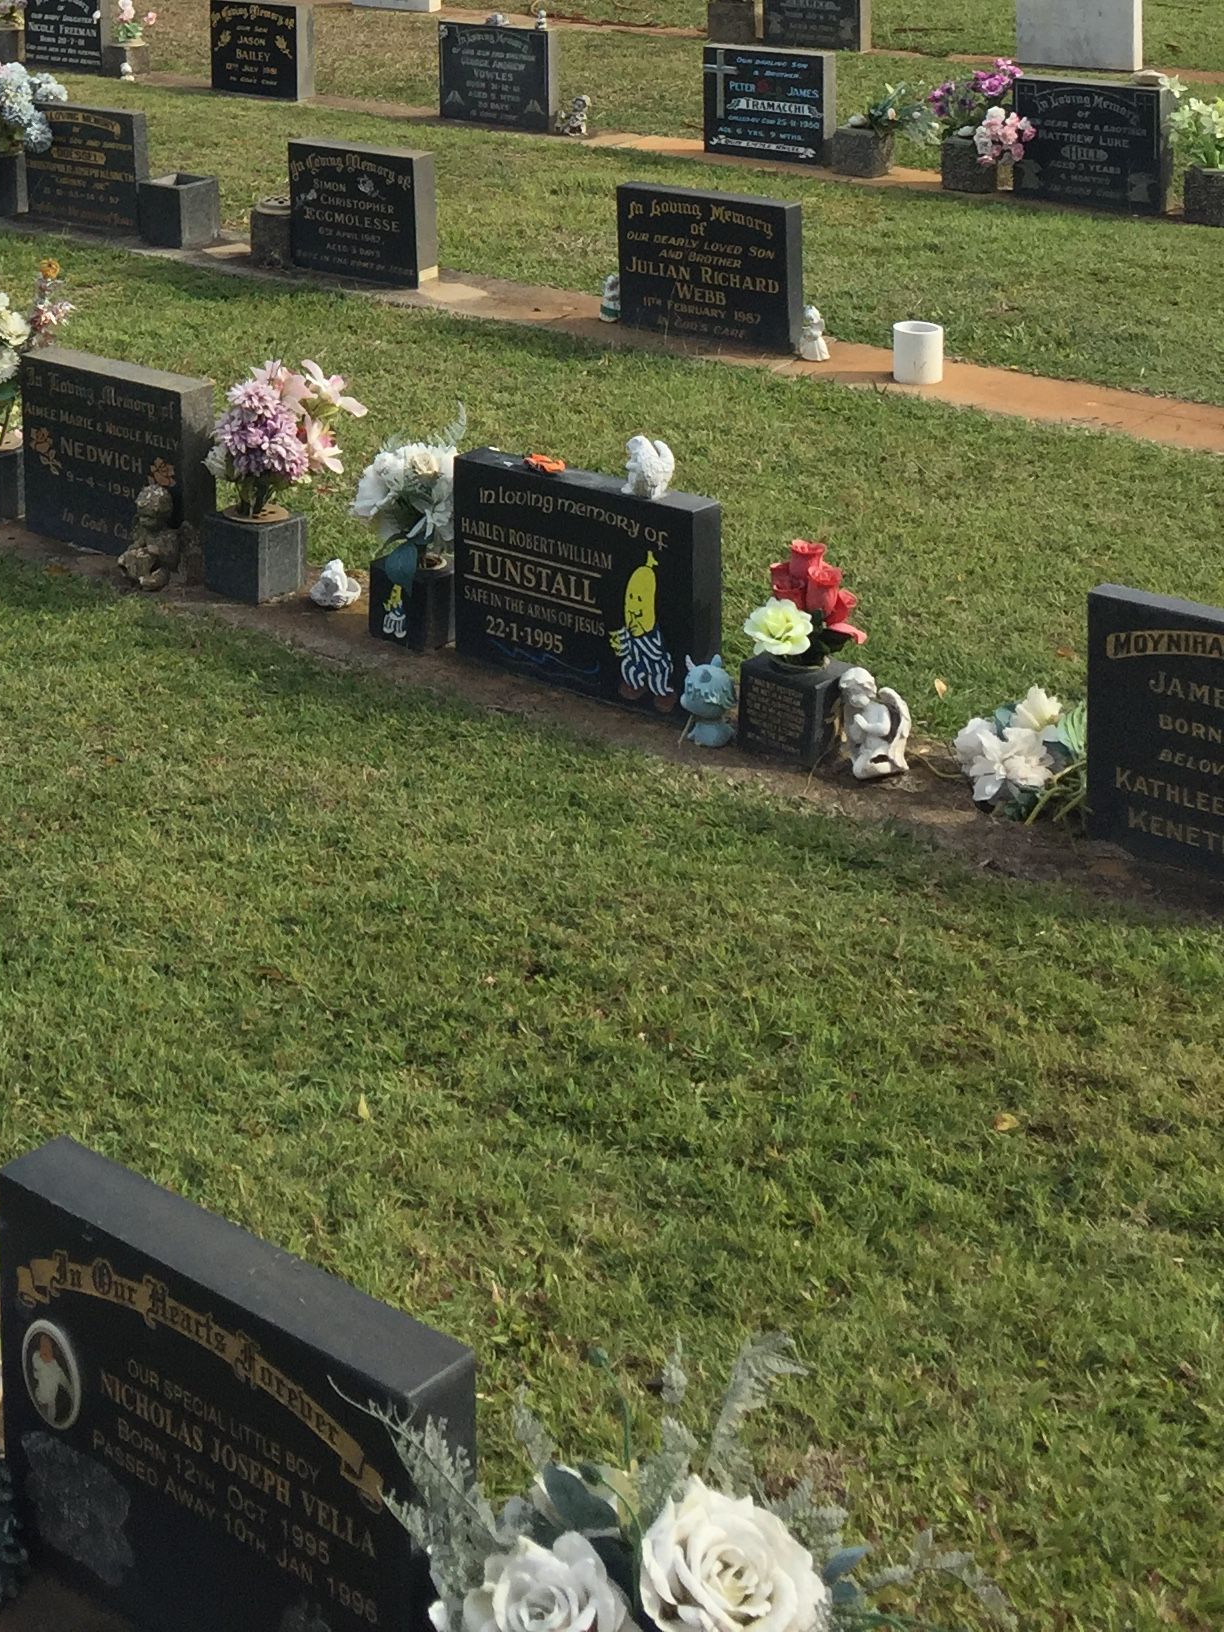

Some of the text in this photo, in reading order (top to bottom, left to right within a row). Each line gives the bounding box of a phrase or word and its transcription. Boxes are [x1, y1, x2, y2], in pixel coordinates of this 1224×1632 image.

[59, 24, 97, 37] FREEMAN
[237, 35, 266, 47] JASON
[235, 48, 271, 62] BAILEY
[473, 68, 514, 82] VOWLES
[729, 80, 820, 99] PETER JAMES
[745, 98, 805, 116] TRAMACCHI
[1050, 93, 1092, 109] Loving
[1038, 129, 1130, 148] MATTHEW LUKE
[306, 153, 345, 174] Loving
[345, 153, 396, 186] Memory
[312, 178, 347, 193] SIMON
[319, 193, 395, 215] CHRISTOPHER
[628, 199, 774, 239] In Loving Memory
[690, 221, 708, 237] of
[626, 231, 776, 260] OUR DEARLY LOVED SON
[658, 249, 743, 269] AND BROTHER
[625, 256, 780, 294] JULIAN RICHARD
[675, 281, 727, 306] WEBB
[668, 300, 728, 320] FEBRUARY
[25, 366, 43, 388] In
[48, 371, 95, 406] Loving
[97, 385, 156, 420] Memory
[59, 410, 94, 431] MARIE
[105, 421, 142, 443] NICOLE
[145, 432, 180, 451] KELLY
[60, 436, 143, 474] NEDWICH
[461, 517, 613, 571] HARLEY ROBERT WILLIAM
[644, 525, 670, 550] of
[469, 548, 598, 605] TUNSTALL
[464, 585, 606, 637] SAFE IN THE ARMS OF JESUS
[1158, 713, 1223, 744] BORN
[51, 1249, 339, 1446] In Our Hearts Forever
[128, 1359, 322, 1484] OUR SPECIAL LITTLE BOY
[101, 1368, 377, 1559] NICHOLAS JOSEPH VELLA
[118, 1417, 167, 1464] BORN
[280, 1519, 330, 1565] 1995
[93, 1429, 158, 1487] PASSED
[165, 1474, 216, 1520] AWAY
[276, 1548, 313, 1584] JAN
[327, 1576, 378, 1624] 1996
